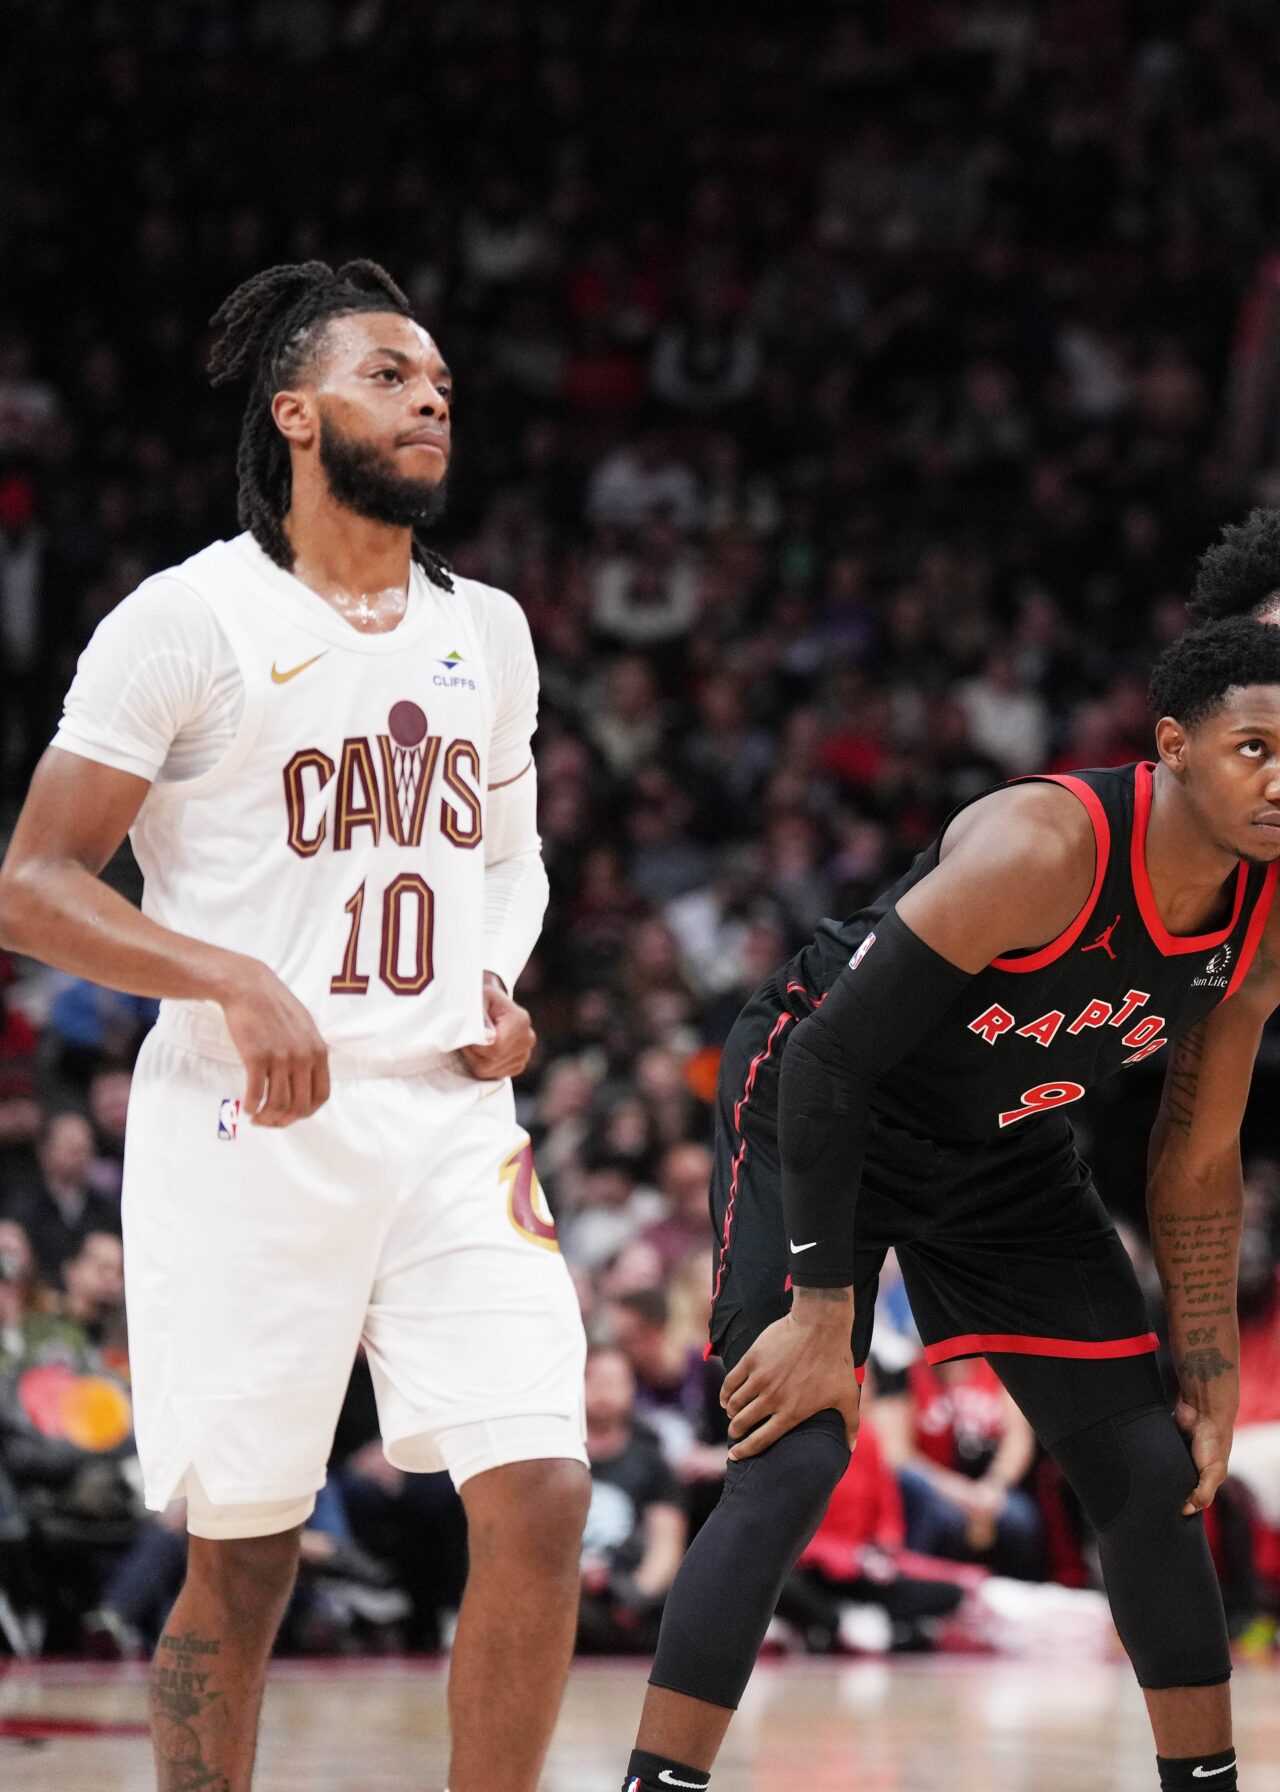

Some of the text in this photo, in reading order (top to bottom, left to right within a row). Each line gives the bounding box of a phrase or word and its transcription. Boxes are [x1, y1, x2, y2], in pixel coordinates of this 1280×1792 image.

[432, 675, 476, 690] CLIFFS
[283, 734, 483, 858] CAVS
[330, 872, 434, 996] 10
[1190, 976, 1228, 988] Sun Life
[967, 989, 1168, 1065] RAPTOR
[998, 1081, 1085, 1129] 9
